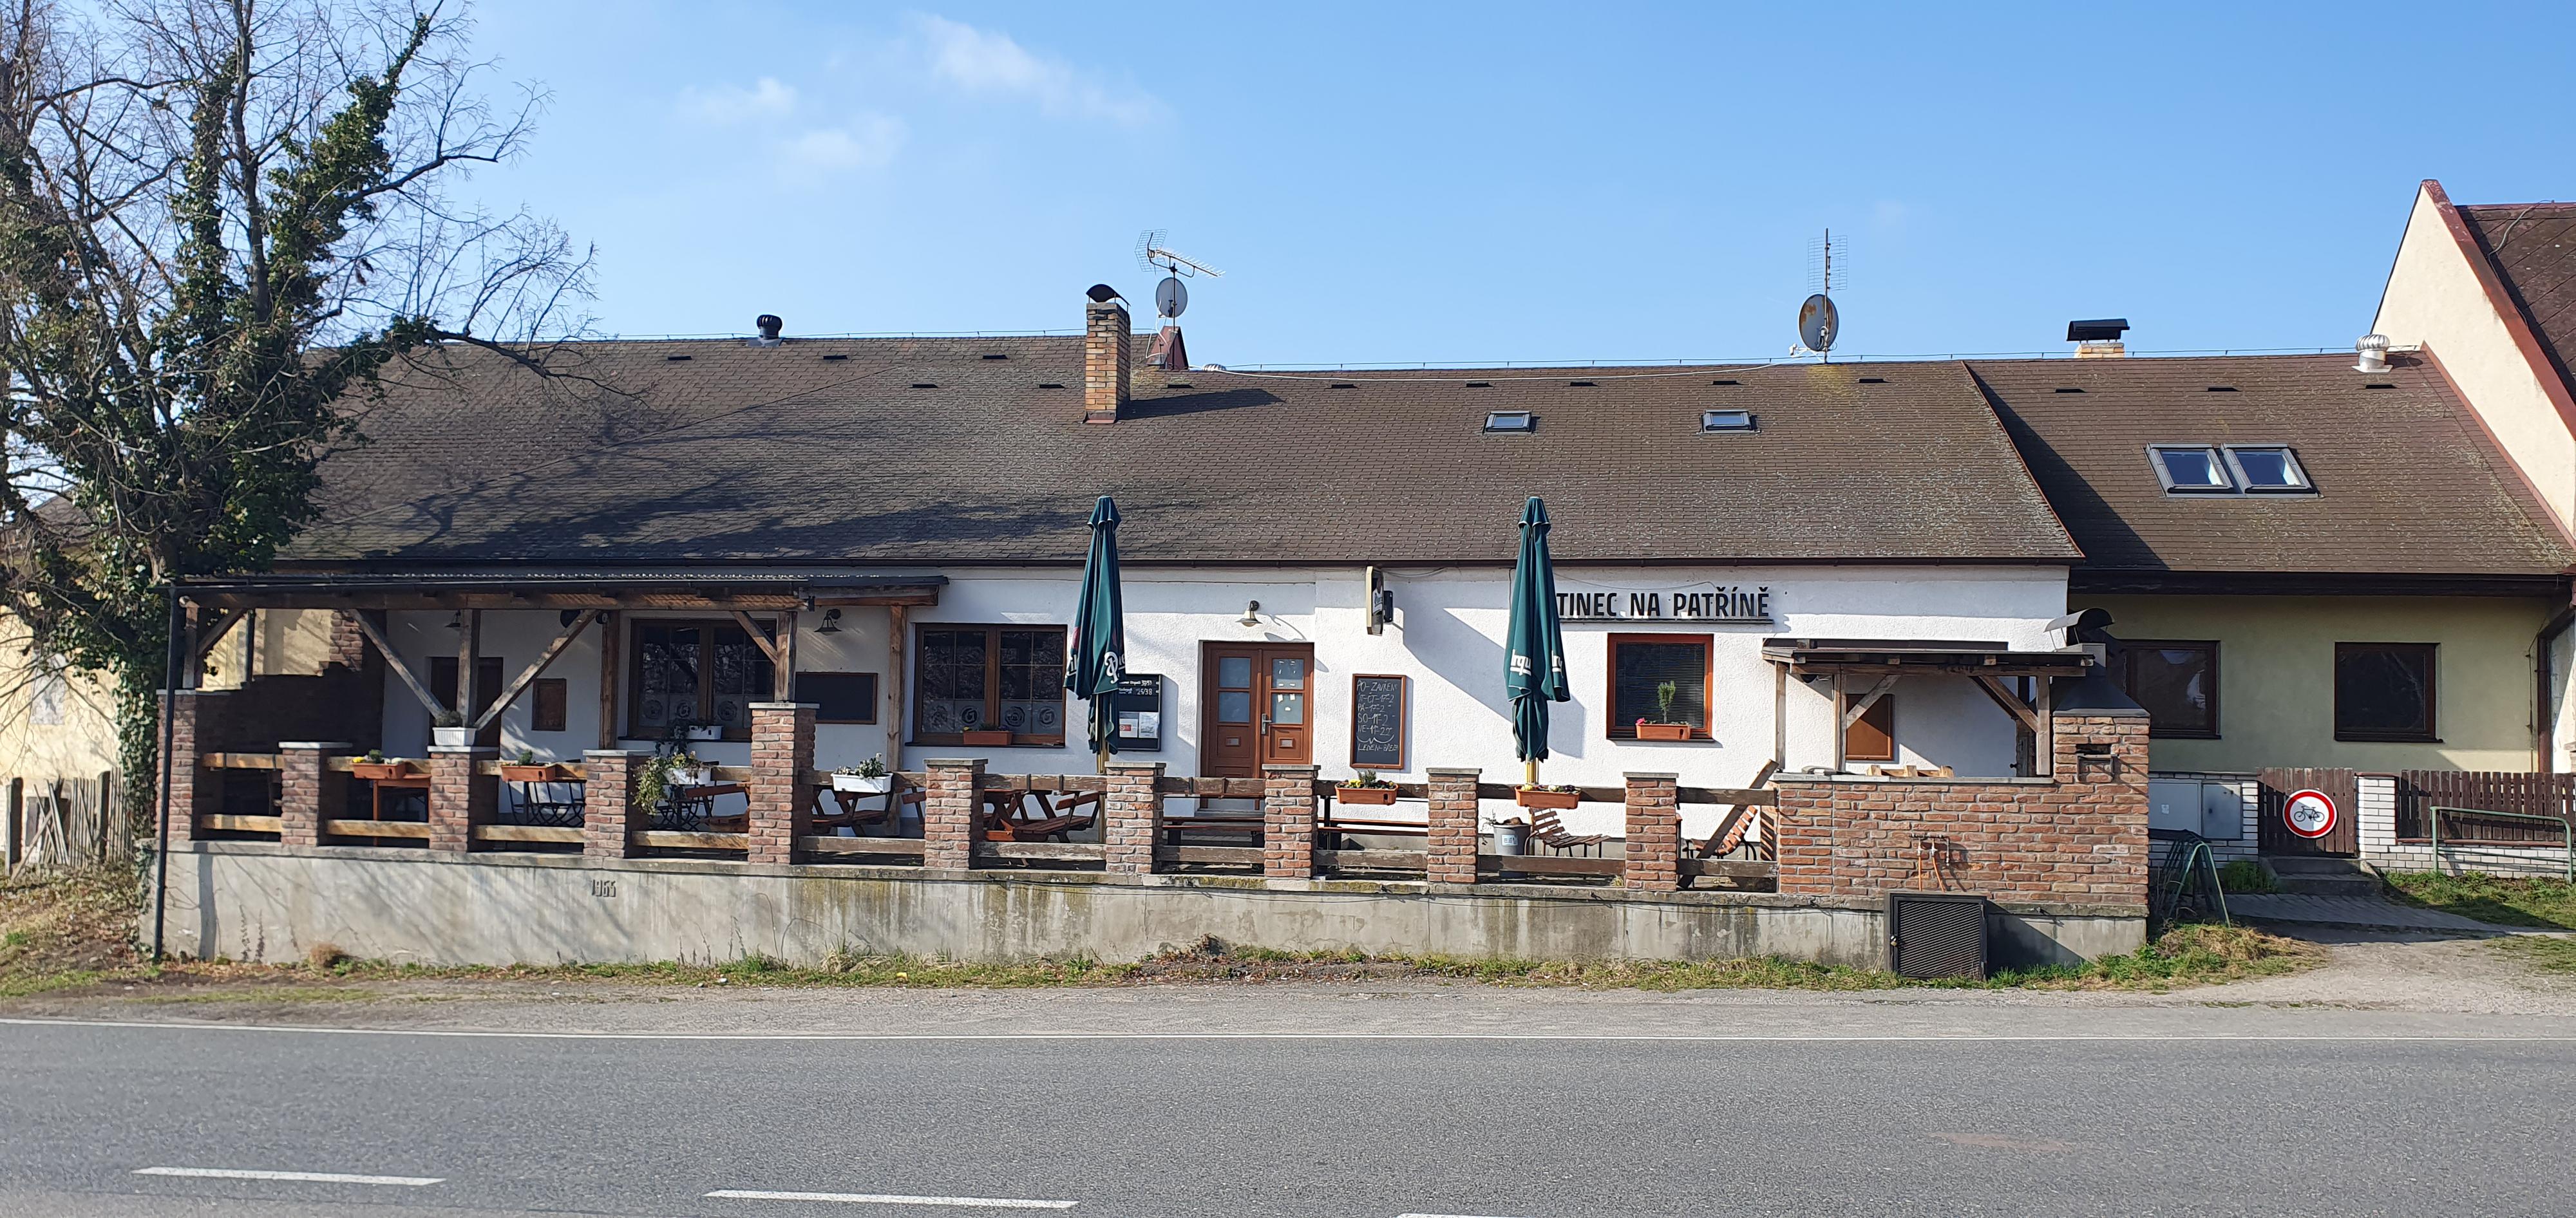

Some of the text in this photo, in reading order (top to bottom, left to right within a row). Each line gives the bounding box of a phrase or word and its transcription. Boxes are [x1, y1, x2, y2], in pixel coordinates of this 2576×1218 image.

[1557, 586, 1769, 617] TINEC NA PATŘÍNĚ
